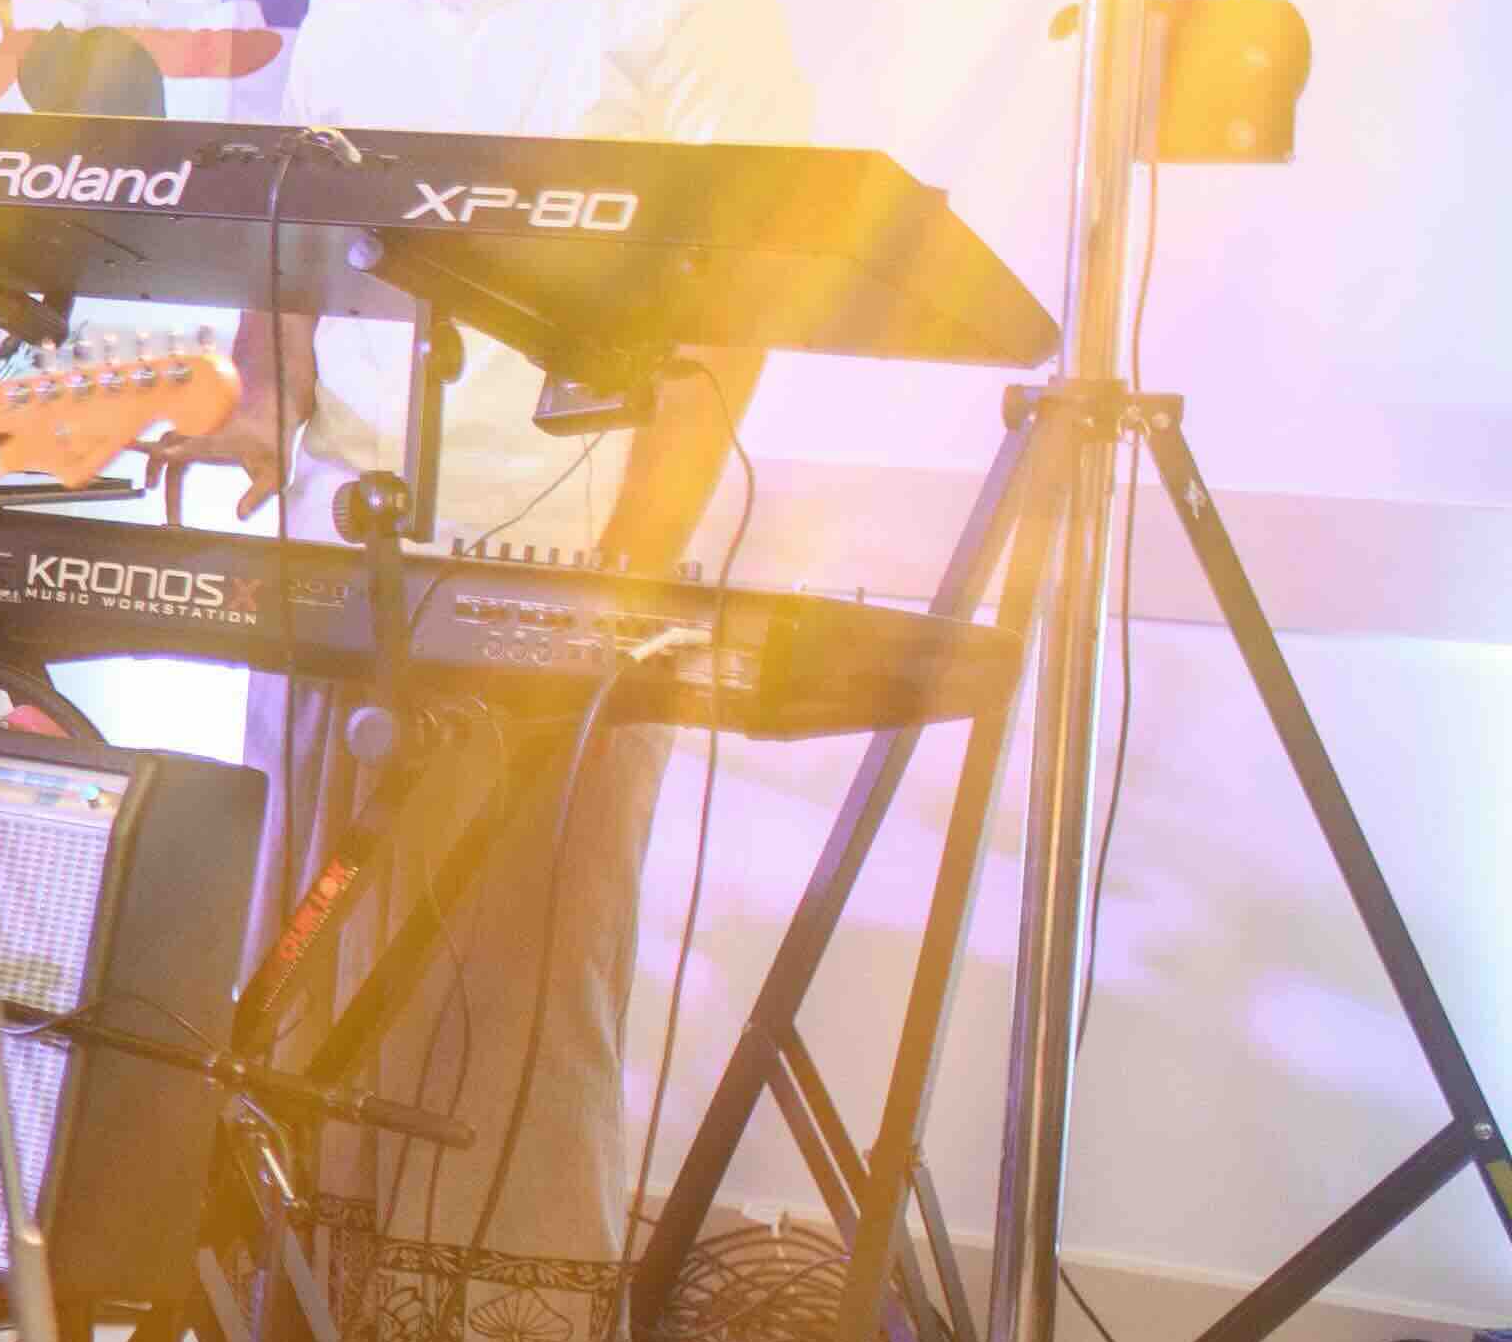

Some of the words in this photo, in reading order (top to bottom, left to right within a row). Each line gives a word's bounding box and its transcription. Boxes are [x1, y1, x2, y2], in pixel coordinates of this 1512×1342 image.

[404, 180, 641, 233] XP-80
[23, 586, 90, 607] MUSIC
[101, 595, 258, 626] WORKSTATION
